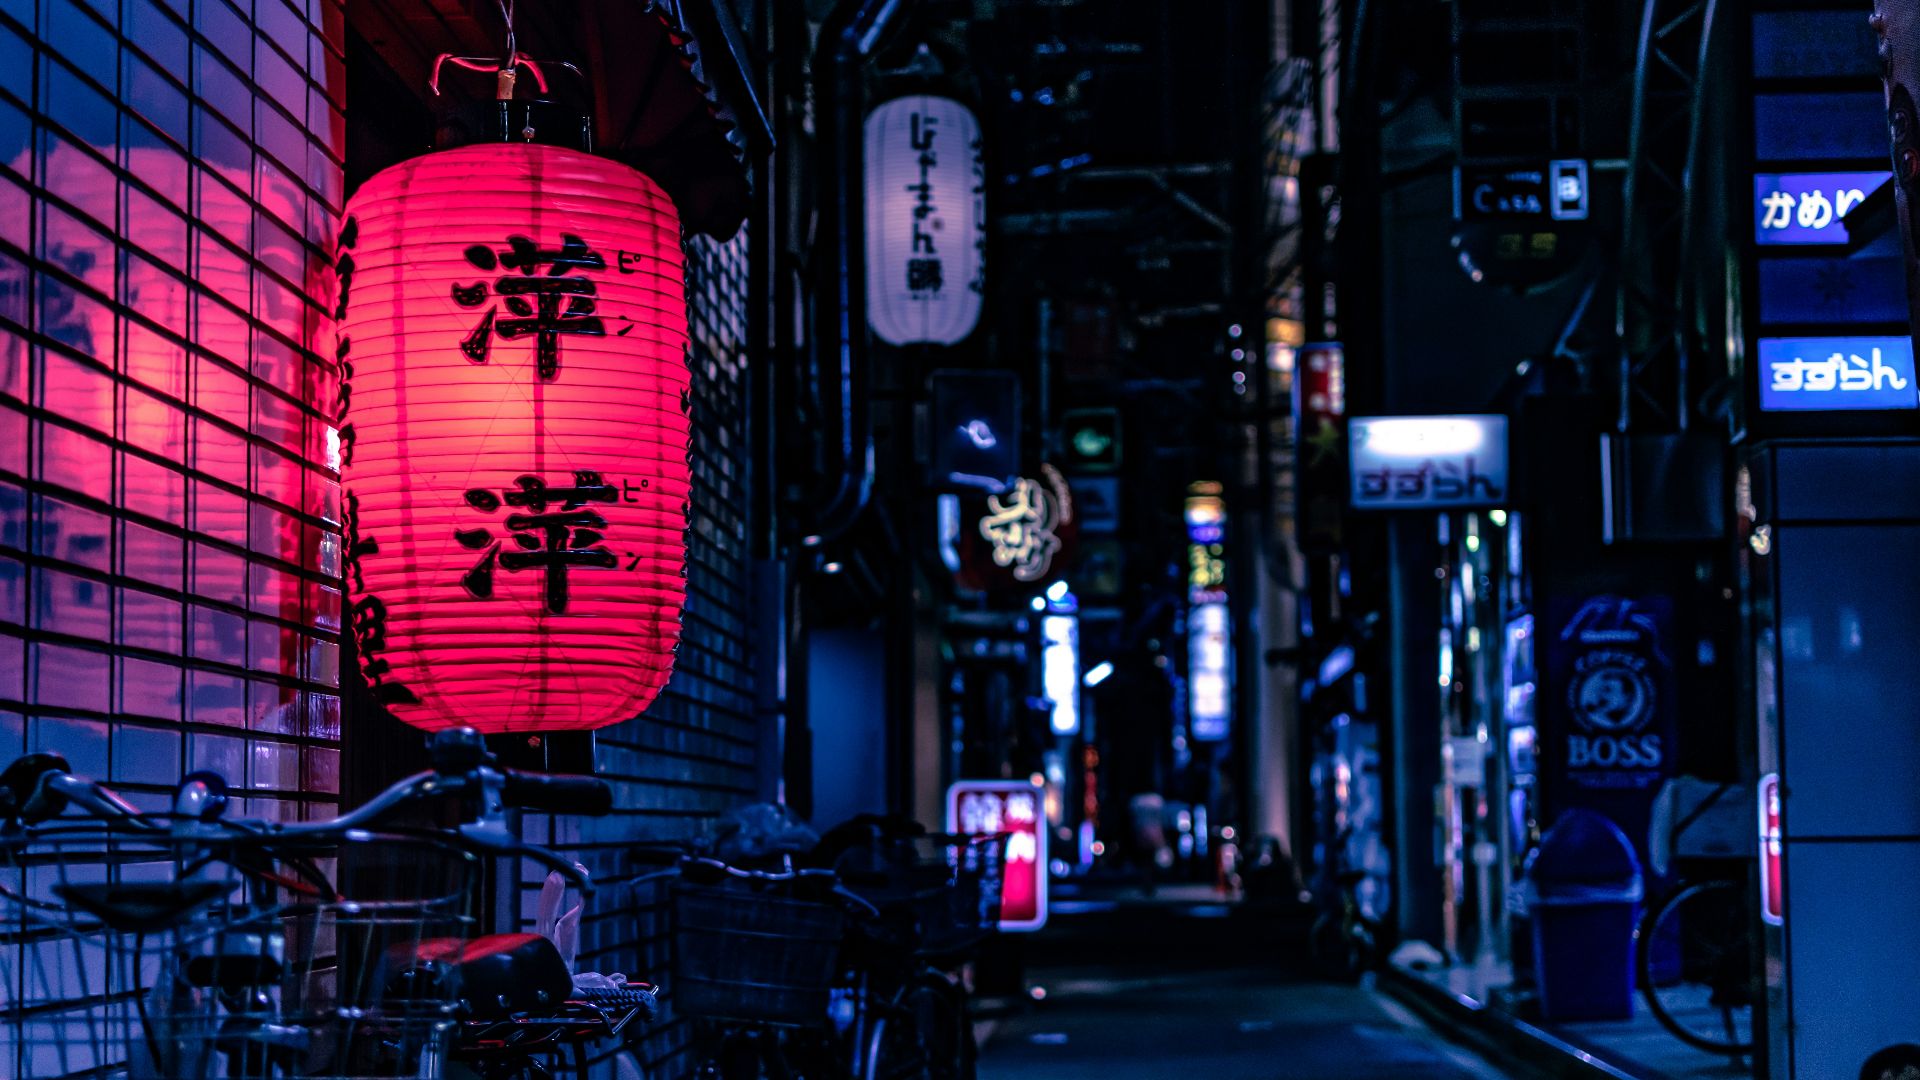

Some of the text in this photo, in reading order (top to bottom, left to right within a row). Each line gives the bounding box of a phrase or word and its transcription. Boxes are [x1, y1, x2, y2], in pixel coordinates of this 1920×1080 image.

[1770, 347, 1908, 392] すずらん
[1567, 733, 1663, 769] BOSS
